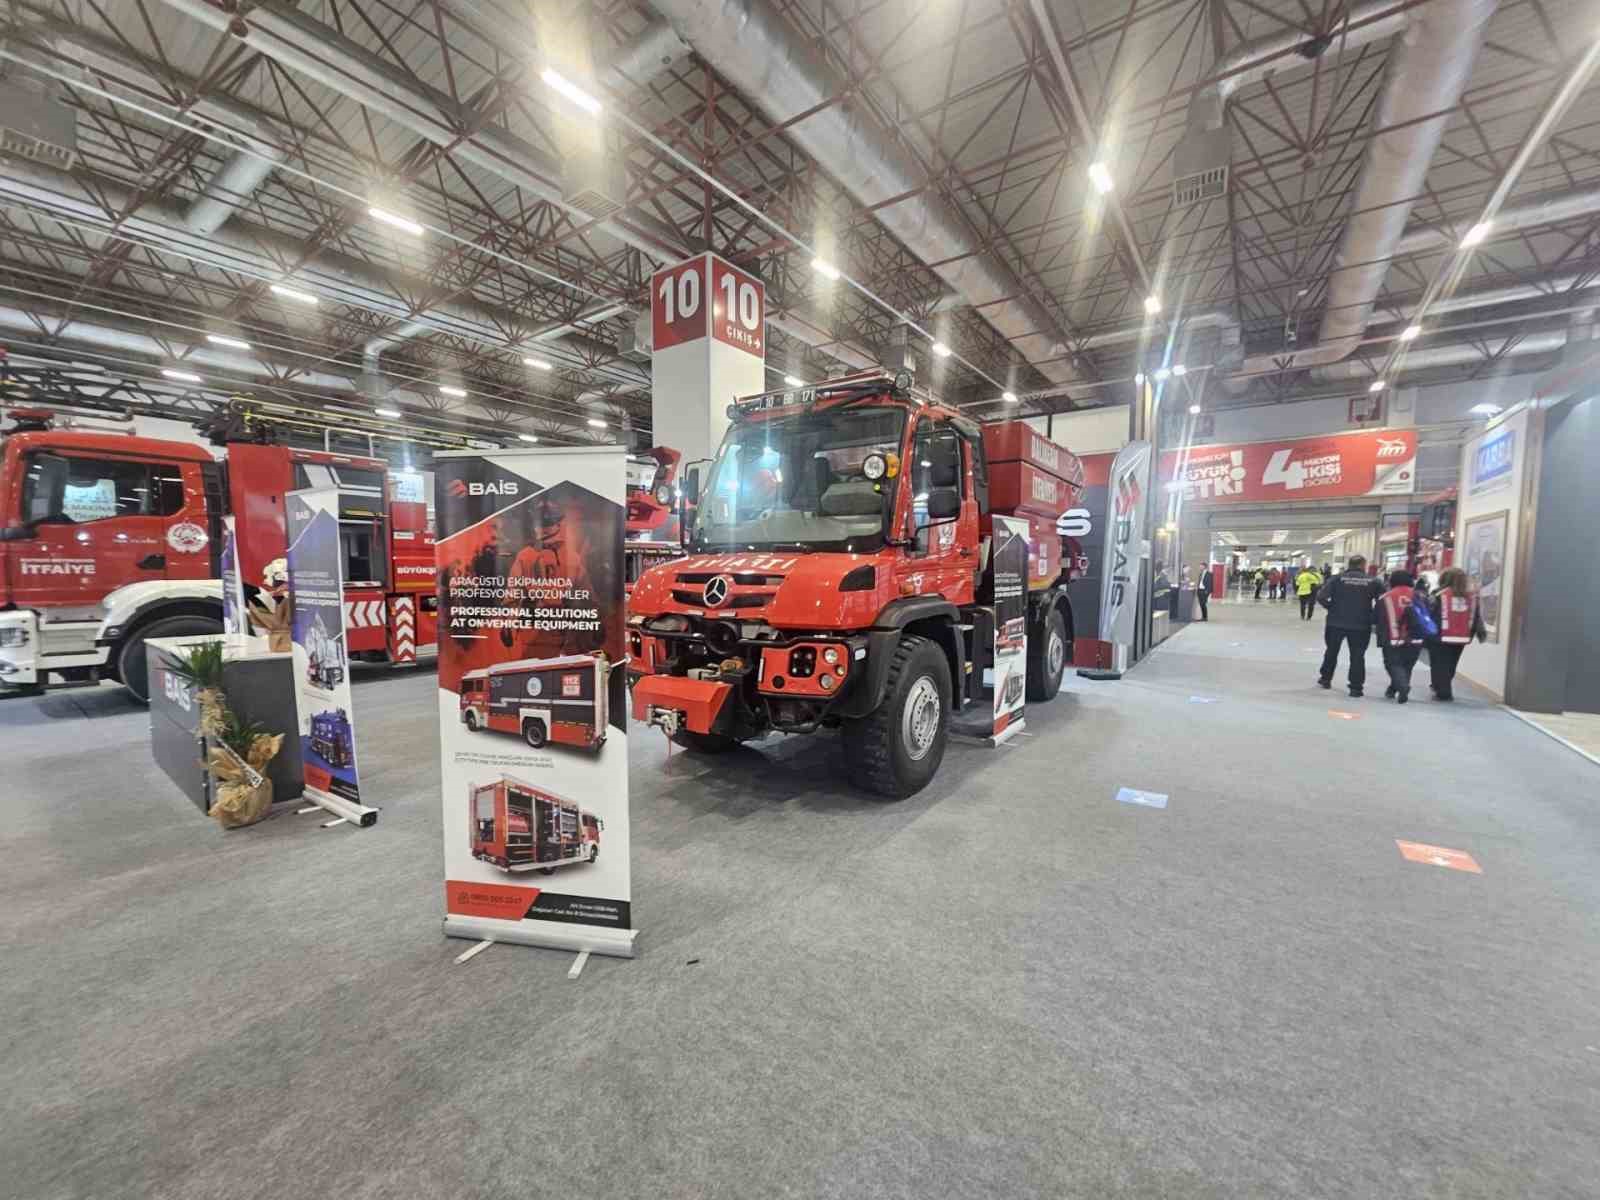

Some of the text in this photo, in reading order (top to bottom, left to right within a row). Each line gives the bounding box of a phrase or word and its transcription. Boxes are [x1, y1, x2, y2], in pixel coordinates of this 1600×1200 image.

[660, 269, 700, 325] 10
[720, 272, 760, 330] 10
[1261, 448, 1306, 490] 4
[469, 480, 519, 495] BAİS
[21, 562, 96, 575] İTFAİYE
[1111, 519, 1131, 607] BAİS
[450, 576, 573, 588] ARAÇÜSTÜ EKİPMANDA
[450, 588, 527, 599] PROFESYONEL
[450, 607, 598, 619] PROFESSIONAL SOLUTIONS
[450, 618, 601, 631] AT ON-VEHICLE EQUIPMENT
